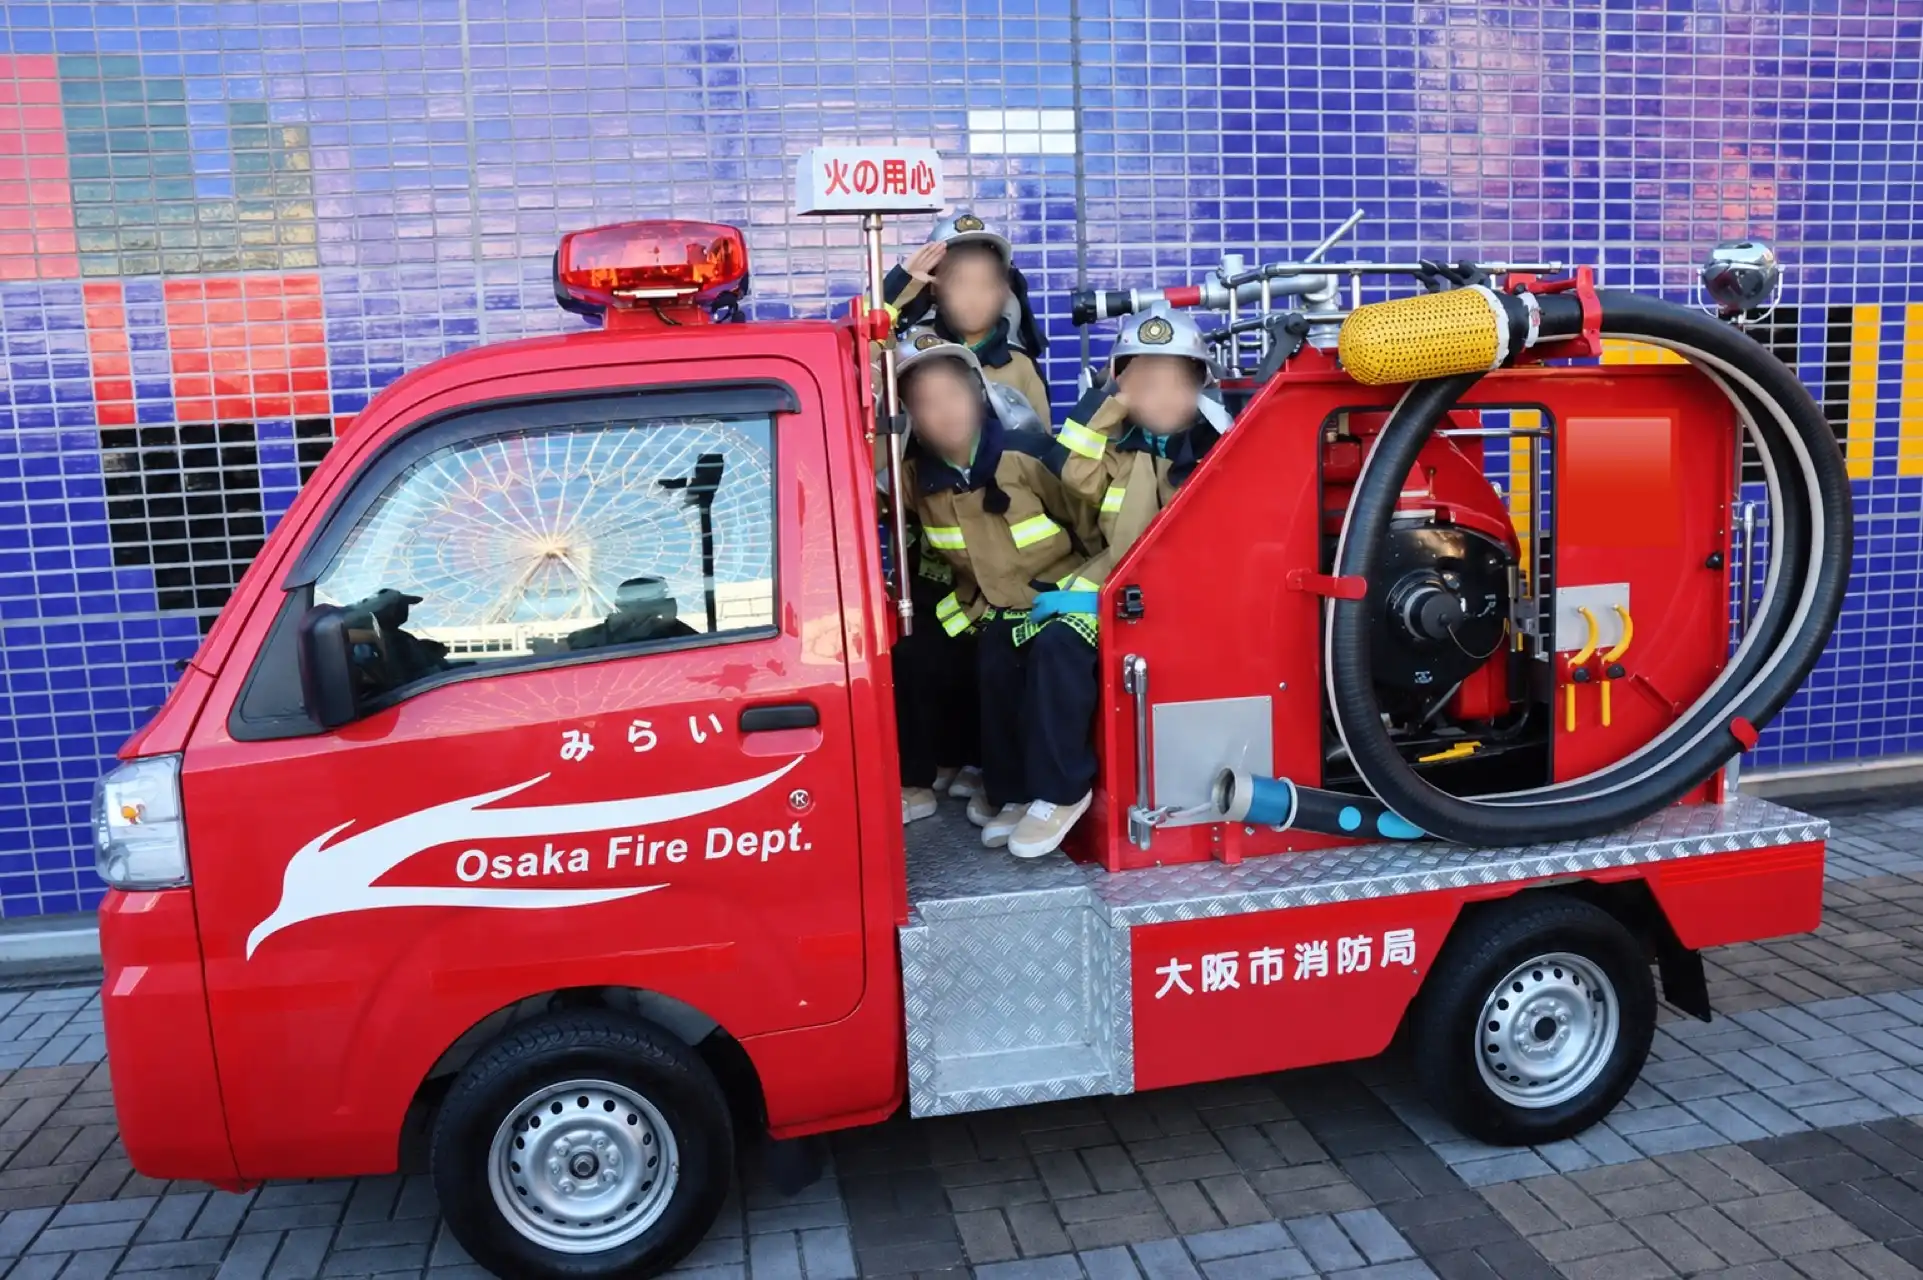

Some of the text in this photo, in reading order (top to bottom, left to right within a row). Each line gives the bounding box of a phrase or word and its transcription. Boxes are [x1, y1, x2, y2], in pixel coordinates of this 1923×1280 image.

[824, 159, 936, 196] 火の用心
[560, 713, 723, 762] みらい
[456, 821, 813, 882] Osaka Fire Dept.
[1154, 928, 1417, 999] 大阪市消防局
